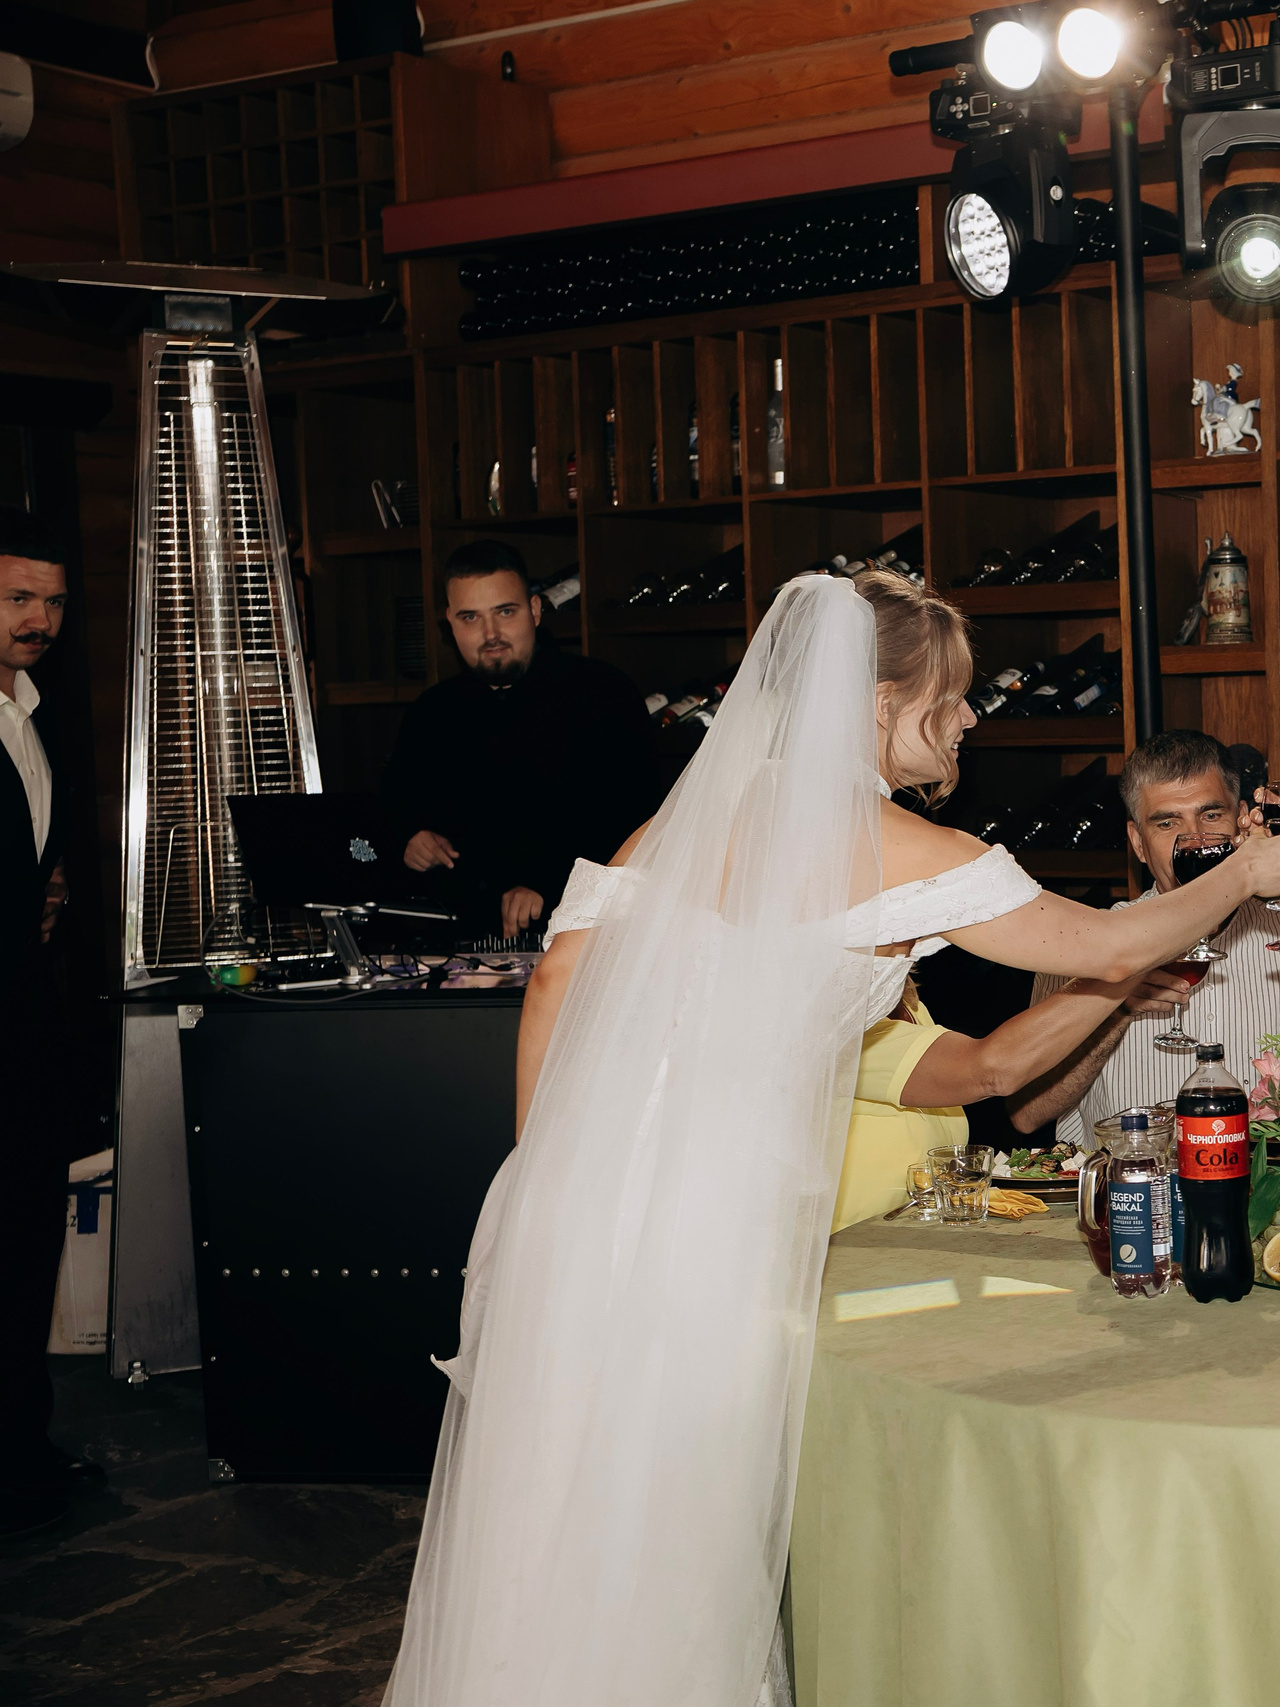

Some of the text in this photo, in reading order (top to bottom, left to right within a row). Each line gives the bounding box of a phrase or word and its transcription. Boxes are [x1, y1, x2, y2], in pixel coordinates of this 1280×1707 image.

[1187, 1132, 1245, 1144] ЧЕРНОГОЛОВКА
[1195, 1148, 1239, 1167] Cola
[1110, 1192, 1144, 1202] LEGEND
[1111, 1202, 1143, 1212] BAIKAL
